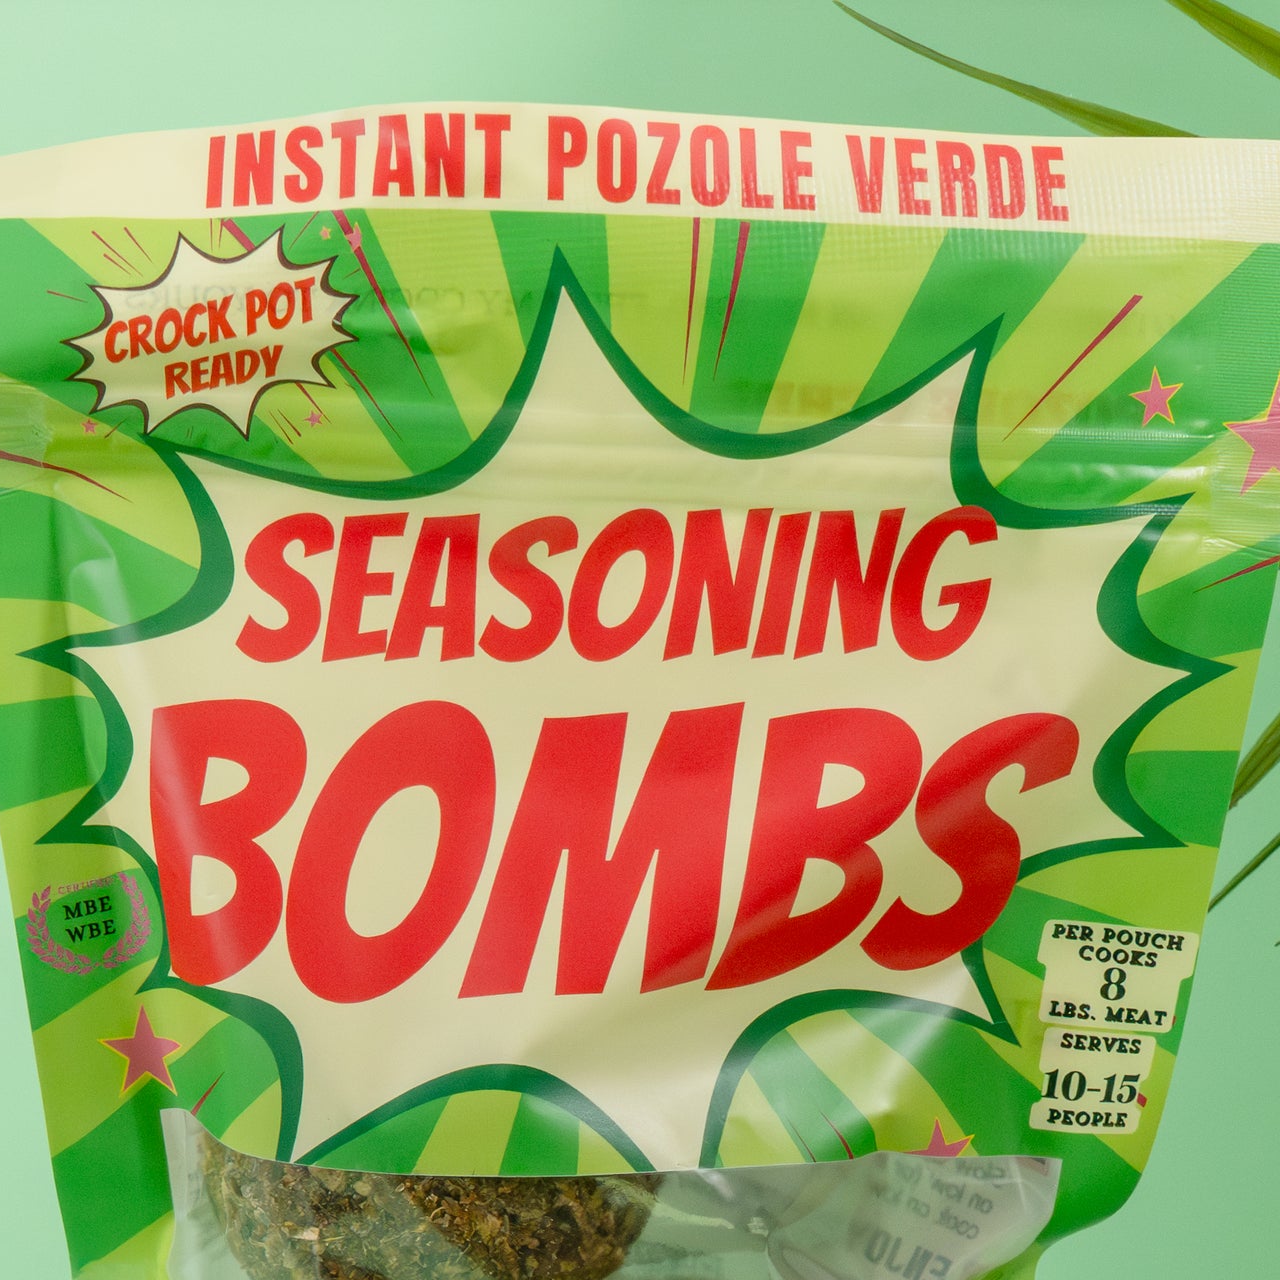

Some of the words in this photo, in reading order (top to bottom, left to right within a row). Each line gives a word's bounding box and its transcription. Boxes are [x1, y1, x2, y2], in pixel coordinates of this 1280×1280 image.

[206, 114, 511, 208] INSTANT
[547, 115, 816, 211] POZOLE
[846, 134, 1069, 222] VERDE
[105, 294, 237, 363] CROCK
[246, 276, 315, 336] POT
[164, 345, 284, 400] READY
[236, 504, 999, 663] SEASONING
[150, 699, 1080, 1004] BOMBS
[62, 896, 112, 920] MBE
[65, 919, 117, 943] WBE
[1051, 924, 1093, 941] PER
[1103, 927, 1185, 951] POUCH
[1078, 945, 1158, 967] COOKS
[1099, 967, 1127, 1001] 8
[1048, 1000, 1096, 1021] LBS.
[1105, 1006, 1167, 1026] MEAT
[1060, 1033, 1142, 1054] SERVES
[1041, 1068, 1141, 1104] 10-15
[1047, 1108, 1127, 1128] PEOPLE
